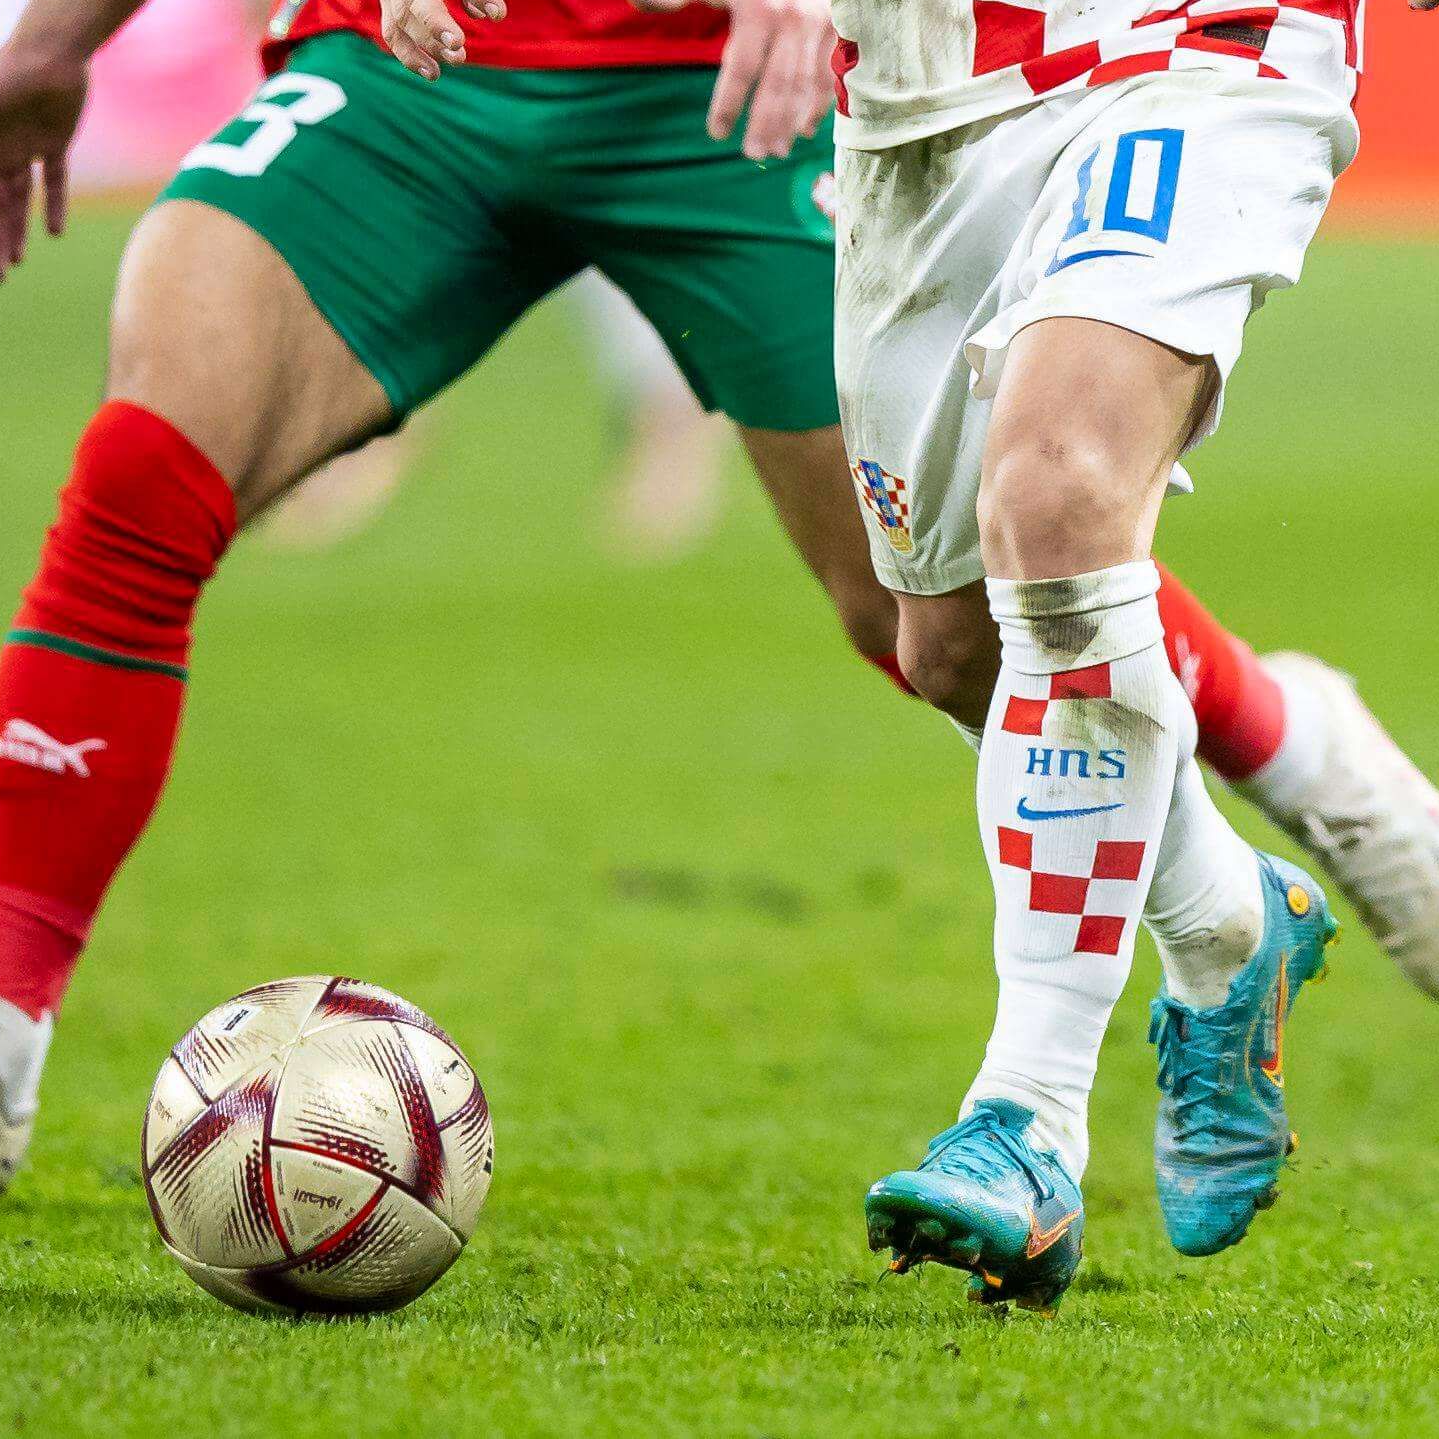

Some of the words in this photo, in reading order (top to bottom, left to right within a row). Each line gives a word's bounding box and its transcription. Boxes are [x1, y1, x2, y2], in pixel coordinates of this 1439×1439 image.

[180, 71, 348, 177] 3
[1062, 127, 1186, 244] 10
[1024, 746, 1127, 779] HNS
